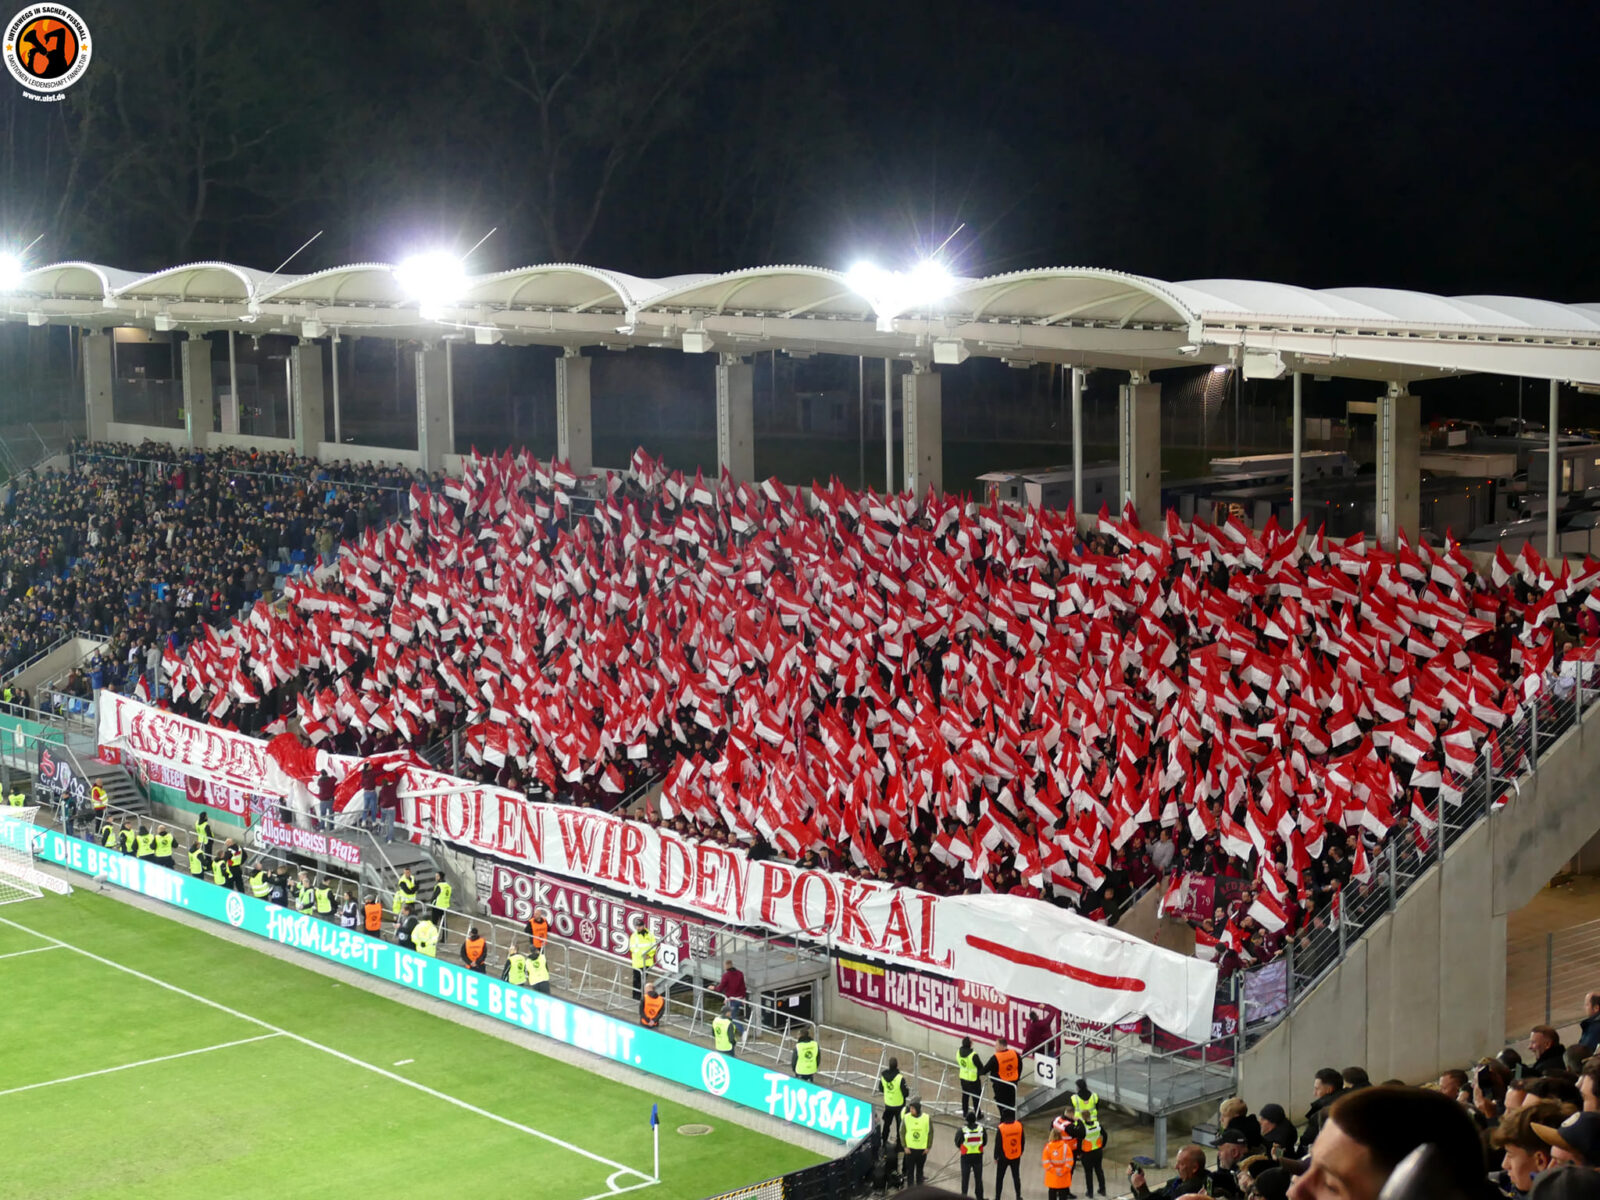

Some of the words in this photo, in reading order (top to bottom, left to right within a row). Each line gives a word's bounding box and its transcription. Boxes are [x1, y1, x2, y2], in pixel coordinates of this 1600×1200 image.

[54, 837, 82, 868] DIE
[262, 817, 292, 845] Allgäu
[293, 829, 327, 854] CHRISSI
[330, 839, 359, 863] Pfalz
[413, 790, 545, 864] HOLEN
[553, 807, 649, 890] WIR
[655, 834, 752, 921] DEN
[759, 862, 955, 970] POKAL
[498, 868, 684, 949] POKALSIEGER
[265, 904, 388, 970] FUSSBALLZEIT
[394, 951, 427, 987] IST
[439, 967, 479, 1007] DIE
[662, 950, 677, 967] C2
[961, 980, 1007, 1005] JUNGS
[1036, 1061, 1054, 1080] C3
